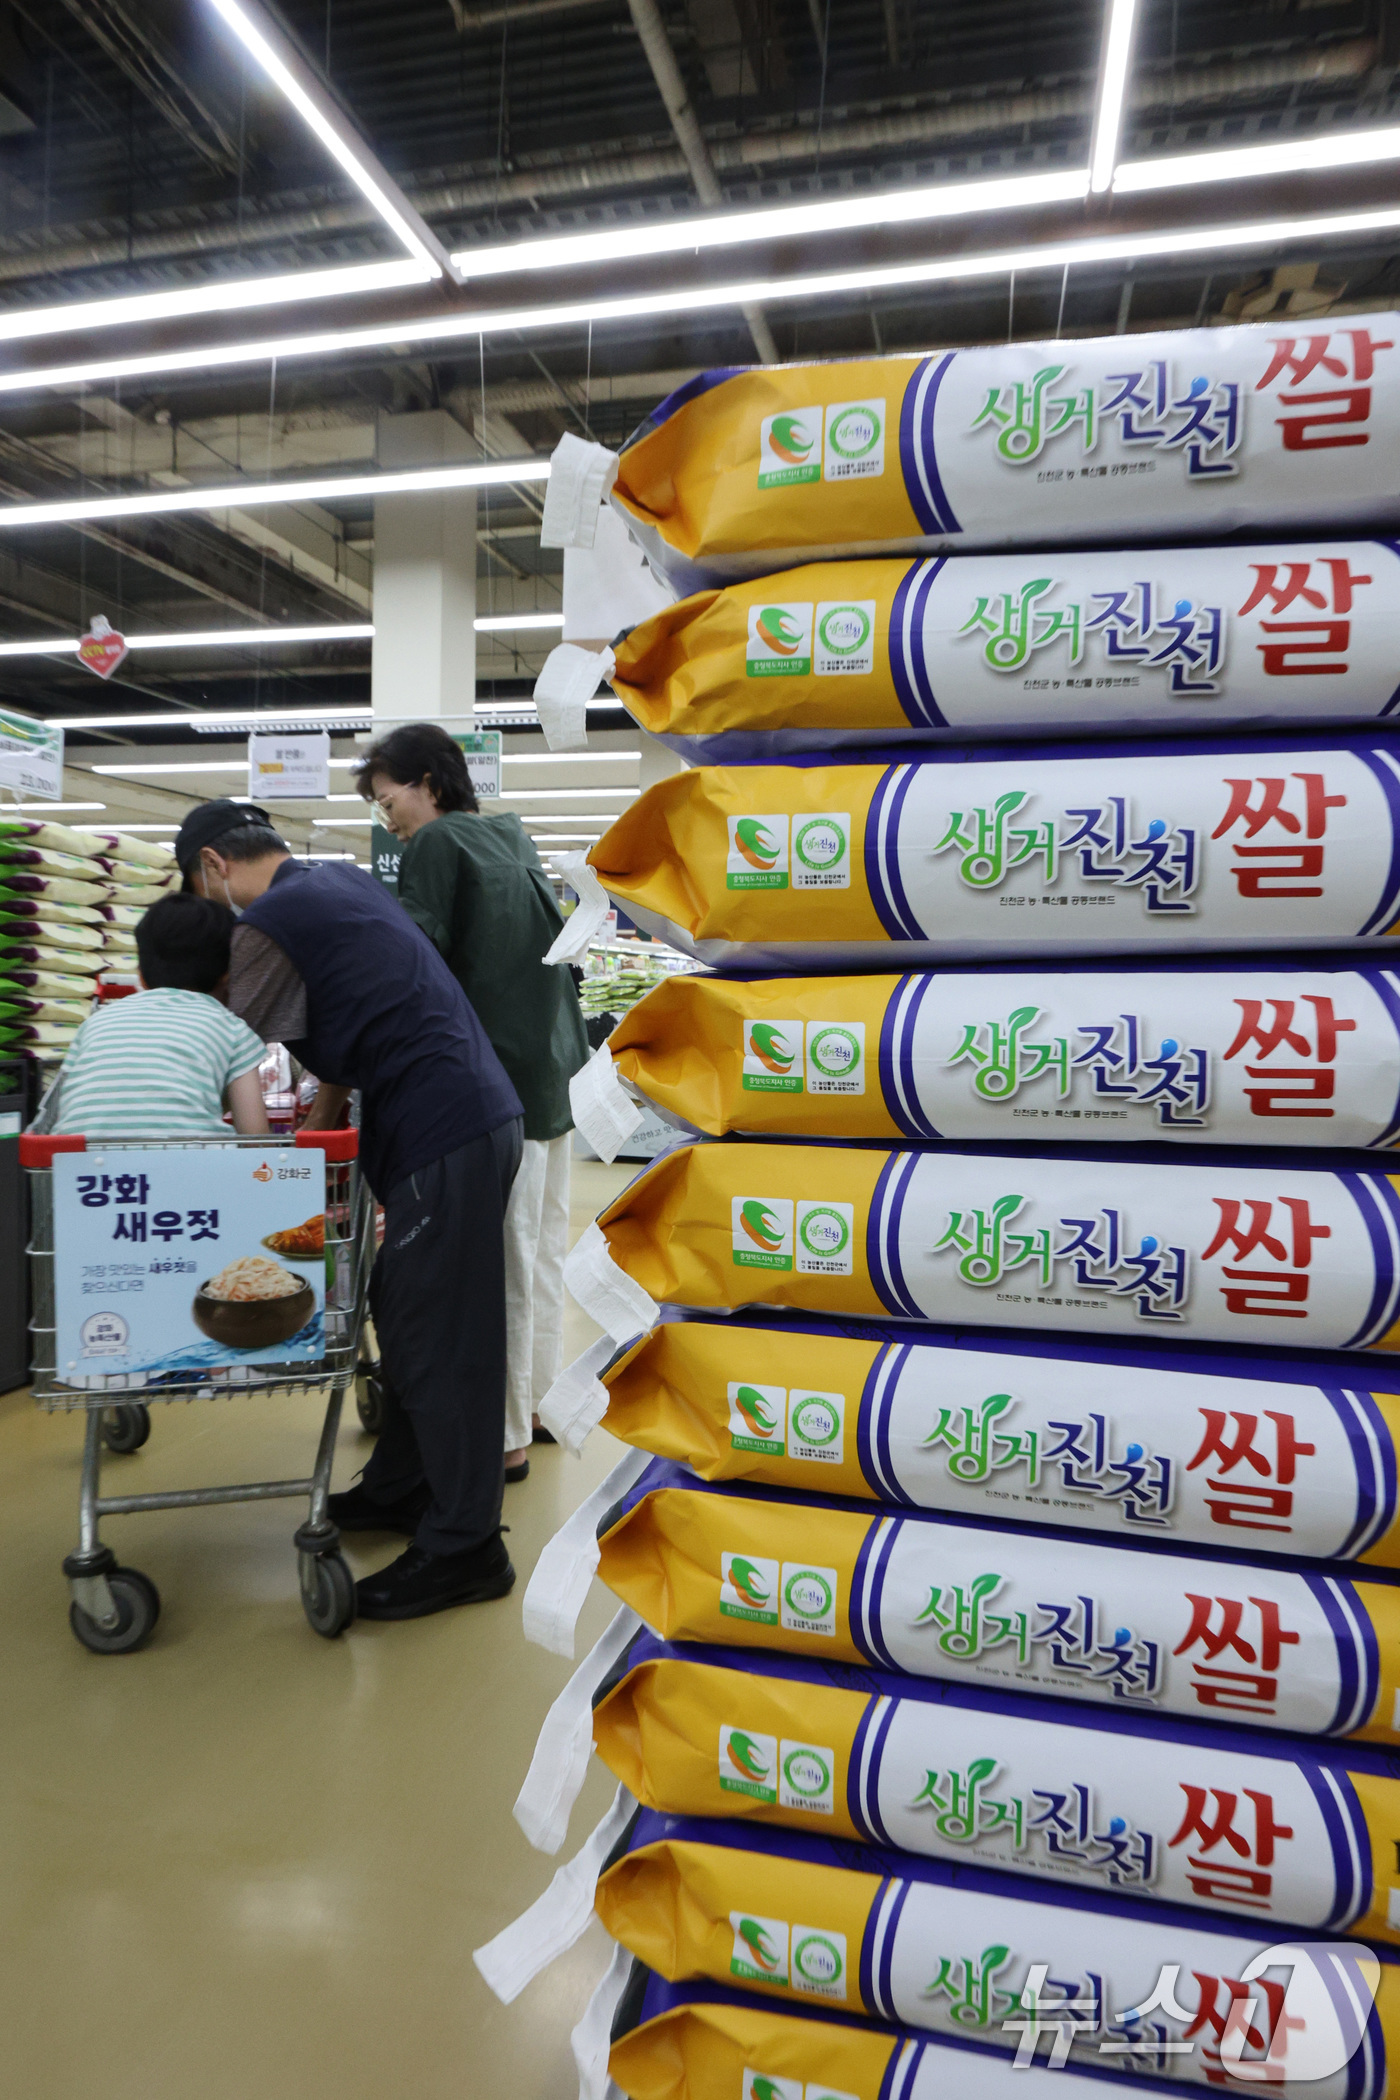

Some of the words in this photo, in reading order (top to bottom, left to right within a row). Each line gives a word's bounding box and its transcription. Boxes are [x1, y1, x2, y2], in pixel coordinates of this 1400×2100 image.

[970, 360, 1239, 475] 생거진천
[1255, 328, 1395, 452] 쌀
[957, 578, 1221, 690] 생거진천
[1238, 558, 1372, 675] 쌀
[933, 791, 1195, 911] 생거진천
[1211, 773, 1347, 897] 쌀
[784, 1079, 797, 1087] 인증
[949, 1007, 1207, 1125] 생거진천
[1223, 995, 1357, 1117] 쌀
[77, 1174, 149, 1207] 강화
[112, 1209, 220, 1242] 새우젓
[277, 1167, 311, 1180] 강화군
[81, 1280, 143, 1294] 찾으신다면
[82, 1265, 106, 1277] 가장
[109, 1264, 145, 1276] 맛있는
[149, 1260, 197, 1274] 새우젓을
[774, 1256, 786, 1264] 인증
[933, 1194, 1186, 1319] 생거진천
[1201, 1196, 1331, 1318] 쌀
[922, 1394, 1171, 1525] 생거진천
[1186, 1407, 1316, 1532] 쌀
[914, 1574, 1158, 1703] 생거진천
[1172, 1593, 1300, 1715] 쌀
[912, 1758, 1158, 1895] 생거진천
[1168, 1783, 1294, 1909] 쌀
